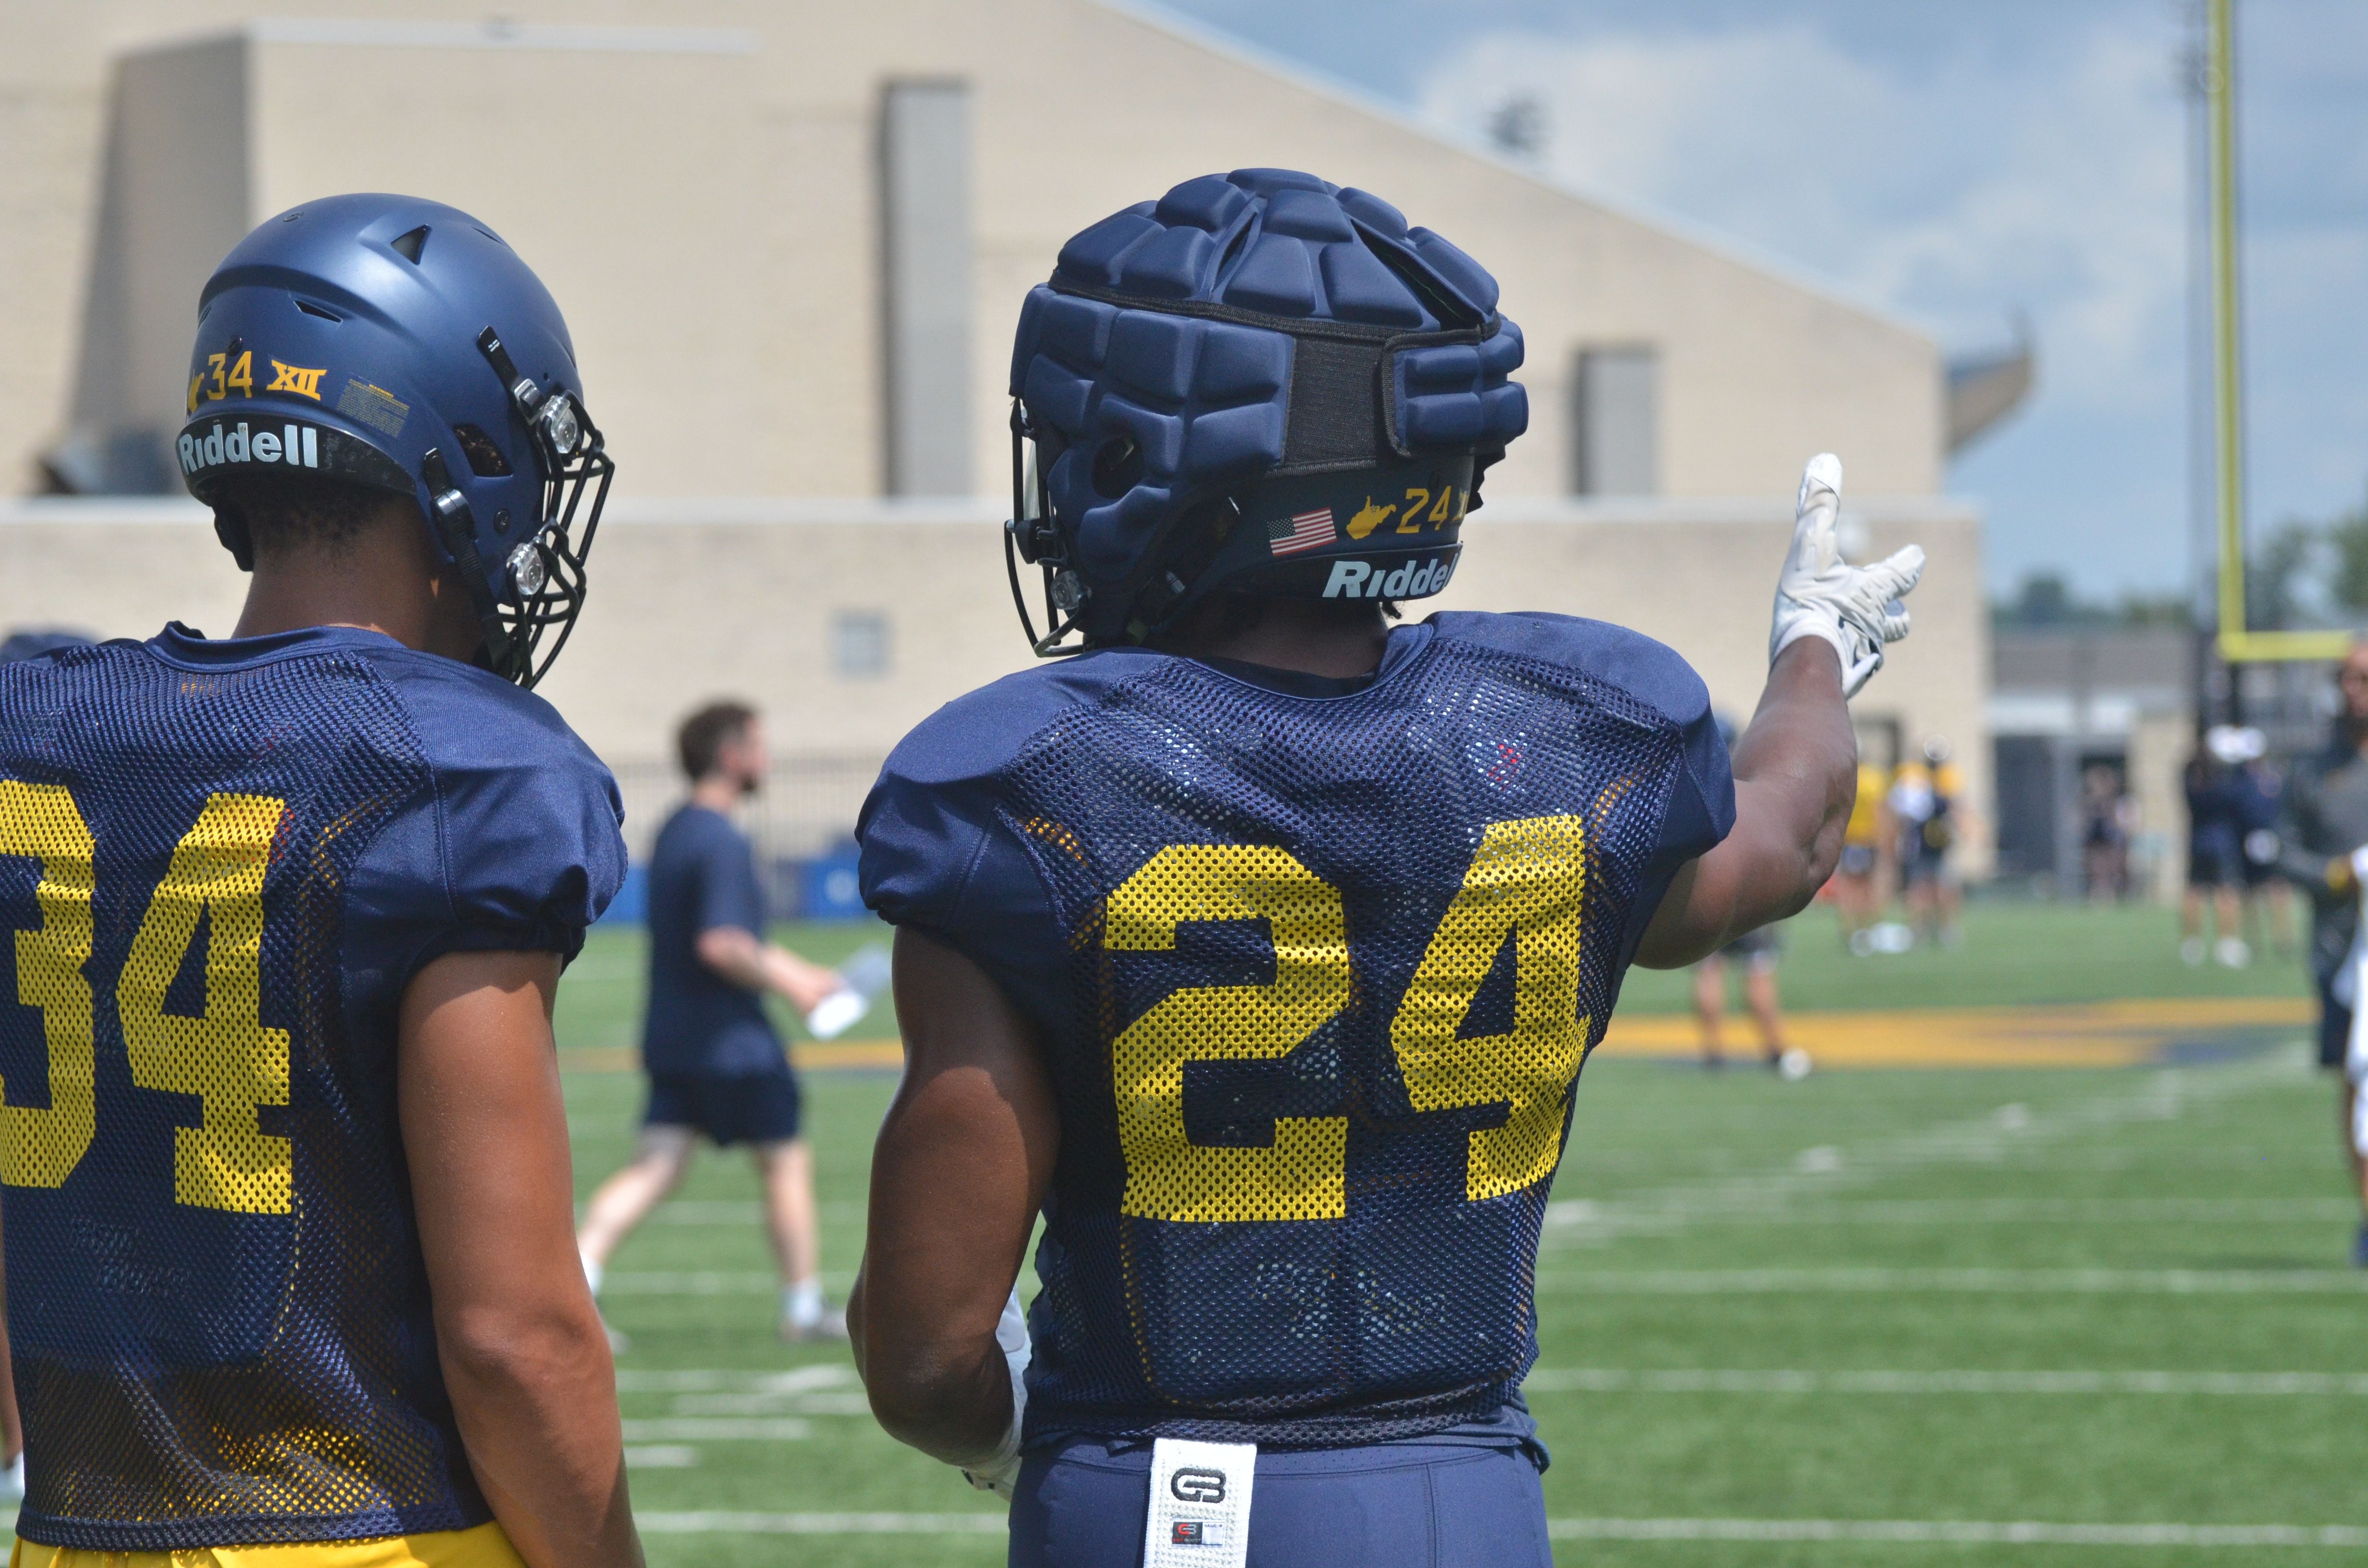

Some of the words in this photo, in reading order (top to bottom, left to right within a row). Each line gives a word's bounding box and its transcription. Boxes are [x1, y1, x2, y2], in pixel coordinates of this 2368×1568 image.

[207, 351, 252, 400] 34
[266, 359, 327, 401] XII
[369, 384, 394, 398] WARNING
[179, 423, 318, 475] Riddell
[1396, 486, 1451, 533] 24
[0, 779, 291, 1214] 34
[1104, 815, 1591, 1222] 24
